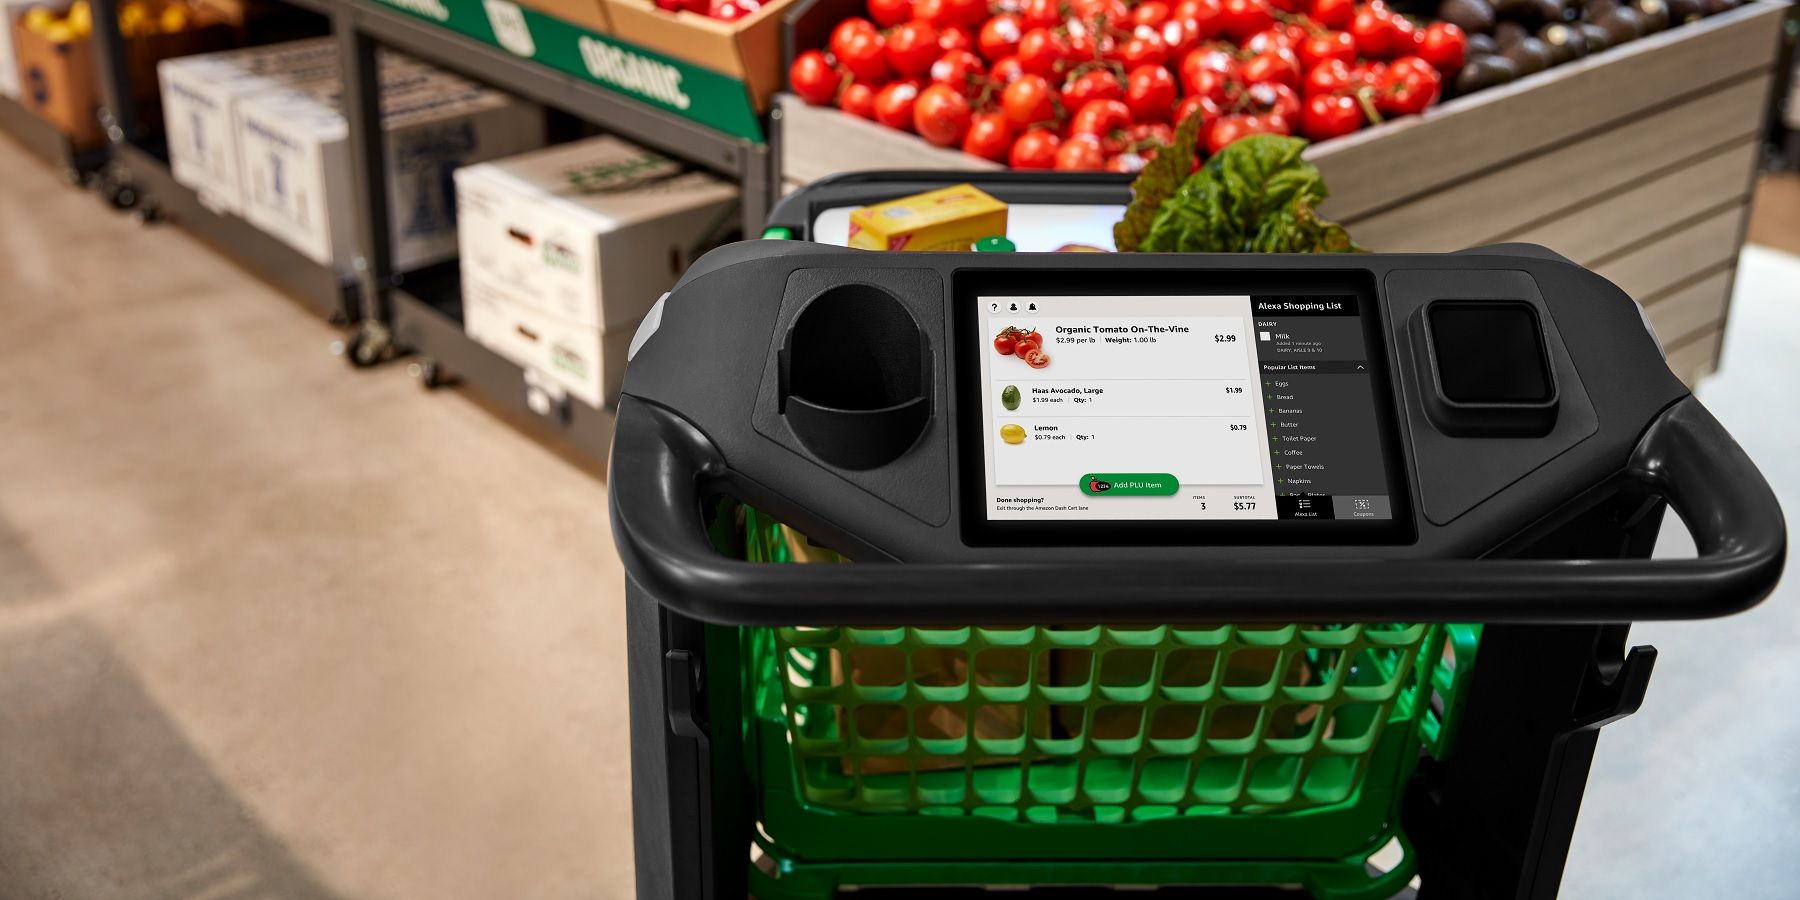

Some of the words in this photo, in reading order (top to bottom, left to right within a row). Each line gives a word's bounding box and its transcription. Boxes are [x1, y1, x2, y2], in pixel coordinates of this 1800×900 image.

[578, 34, 691, 110] ORGANIC
[1258, 302, 1282, 310] Alexa
[1283, 302, 1325, 311] Shopping
[1326, 302, 1342, 310] List
[1055, 325, 1091, 335] Organic
[1093, 325, 1129, 334] Tomato
[1131, 325, 1189, 334] On-The-Vine
[1104, 337, 1132, 345] Weight:
[1214, 334, 1237, 343] $2.99
[1050, 387, 1083, 395] Avocado,
[1084, 387, 1104, 395] Large
[1225, 386, 1243, 394] $1.99
[1113, 481, 1128, 489] Add
[1129, 481, 1144, 489] PLU
[1145, 481, 1162, 489] Item
[1200, 502, 1206, 510] 3
[1233, 502, 1256, 511] $5.77
